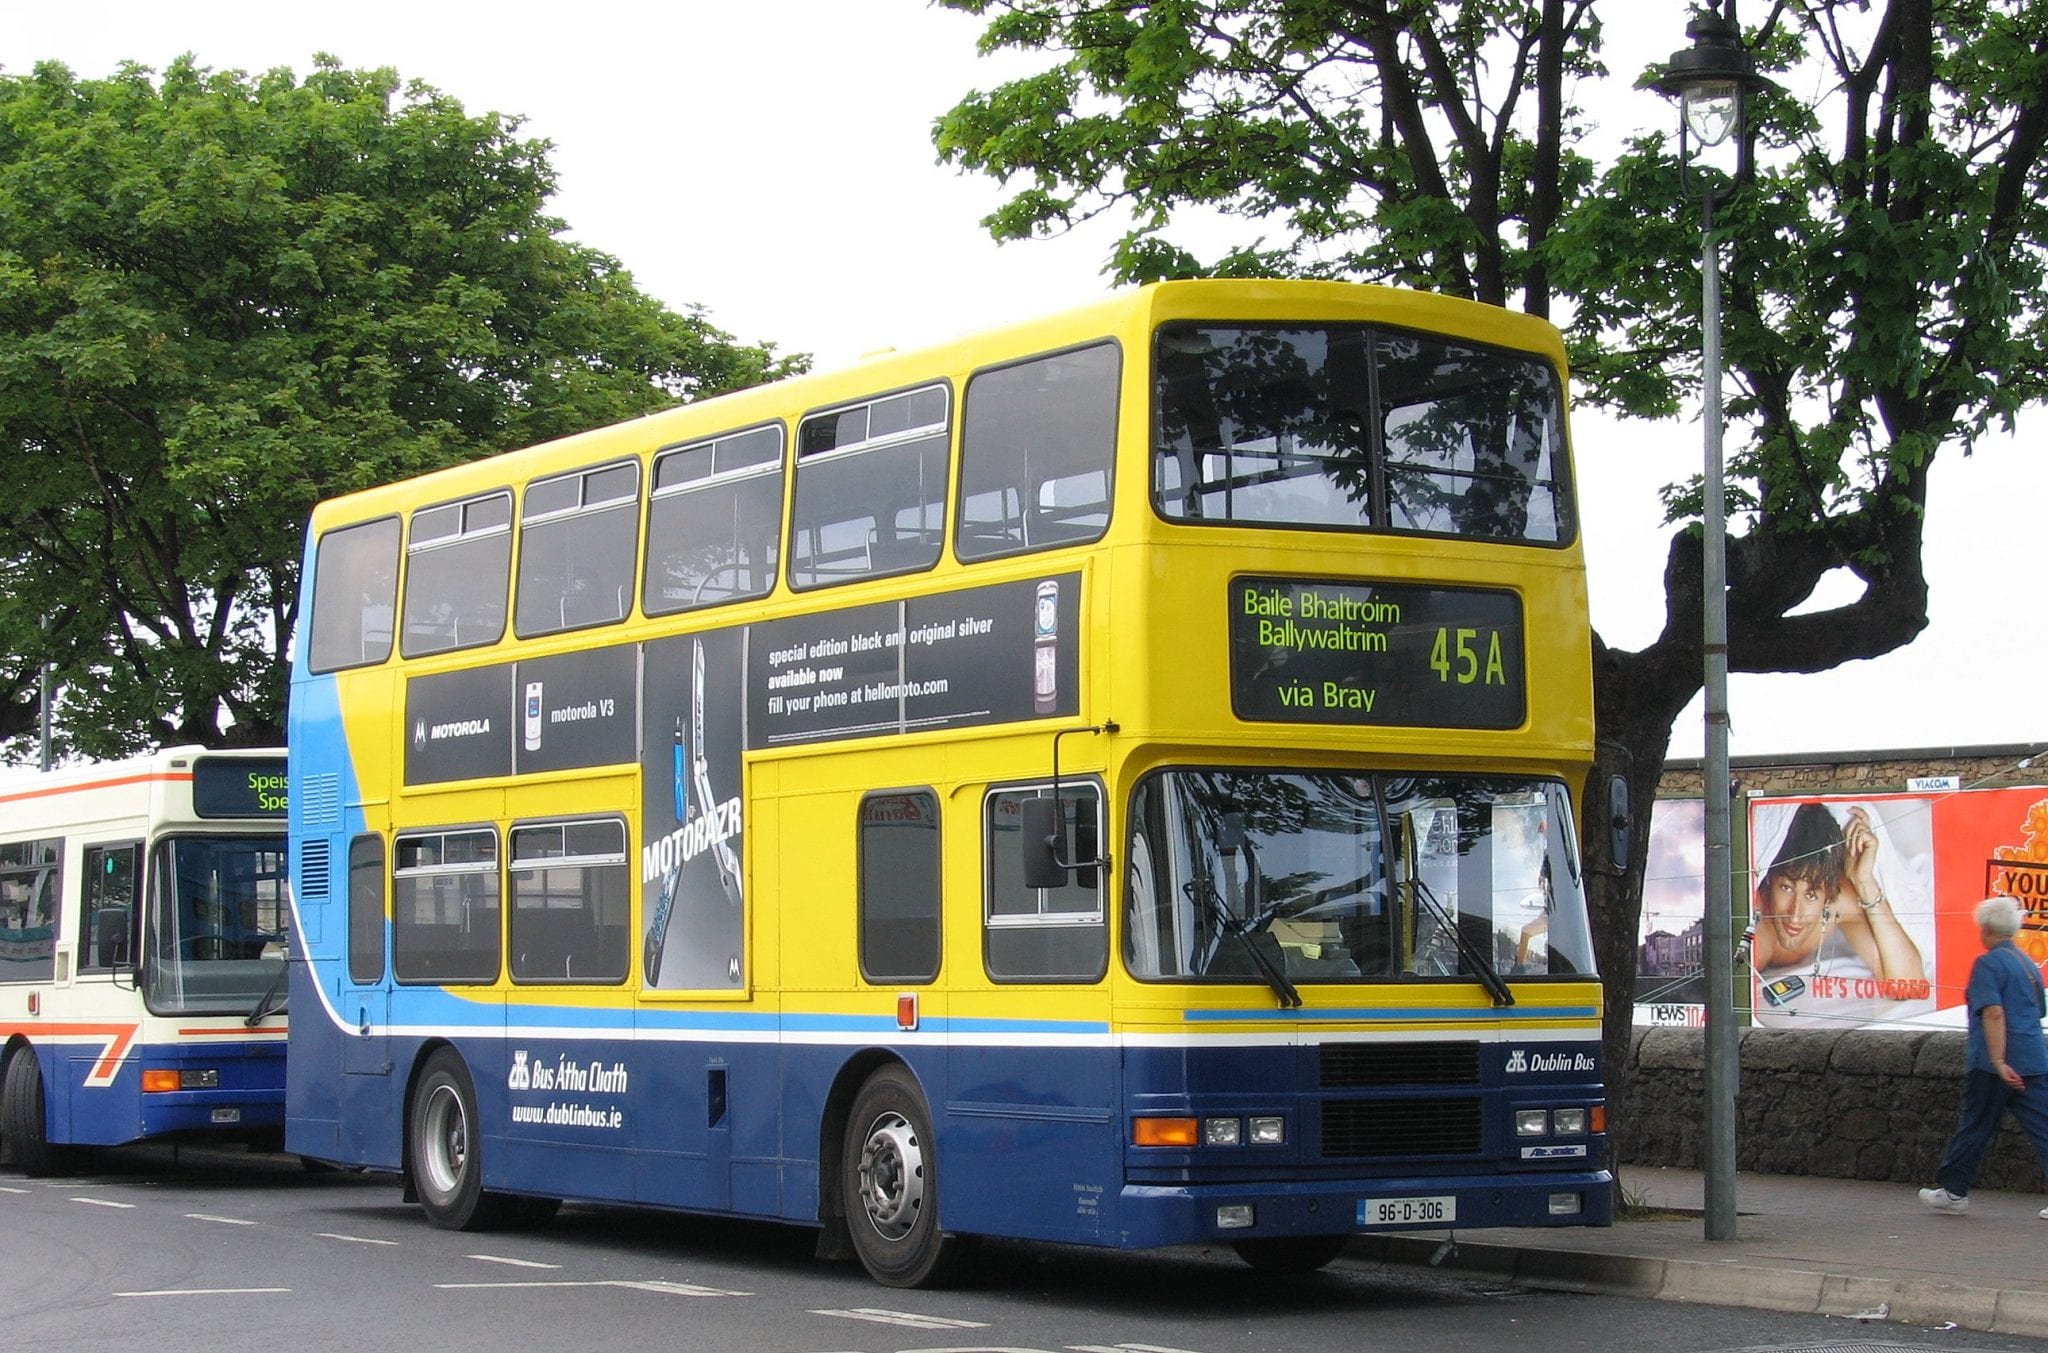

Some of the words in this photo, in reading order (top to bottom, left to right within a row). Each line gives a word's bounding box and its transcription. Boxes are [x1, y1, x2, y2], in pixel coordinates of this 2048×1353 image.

[1244, 589, 1292, 617] Baile
[1300, 591, 1400, 623] Bhaltroim
[769, 643, 807, 668] special
[809, 638, 848, 659] edition
[850, 631, 882, 652] black
[910, 619, 956, 646] original
[958, 616, 993, 637] silver
[1258, 620, 1387, 652] Ballywaltrim
[768, 667, 817, 690] available
[819, 665, 844, 682] now
[768, 697, 783, 714] fill
[786, 694, 812, 716] your
[813, 690, 848, 713] phone
[850, 689, 863, 704] at
[864, 678, 949, 702] hellomoto.com
[1278, 679, 1314, 707] via
[1323, 682, 1376, 712] Bray
[551, 701, 597, 723] motorola
[600, 699, 615, 717] V3
[430, 718, 490, 740] MOTOROLA
[1914, 778, 1951, 789] VIACOM
[642, 796, 742, 885] MOTORAZR
[1812, 976, 1848, 998] HE'S
[1854, 979, 1931, 1000] COVERED
[532, 1059, 554, 1090] Bus
[555, 1052, 588, 1091] Átha
[1530, 1053, 1573, 1072] Dublin
[1574, 1053, 1595, 1071] Bus
[512, 1101, 622, 1129] www.dublinbus.ie
[1378, 1202, 1442, 1221] 96-D-306
